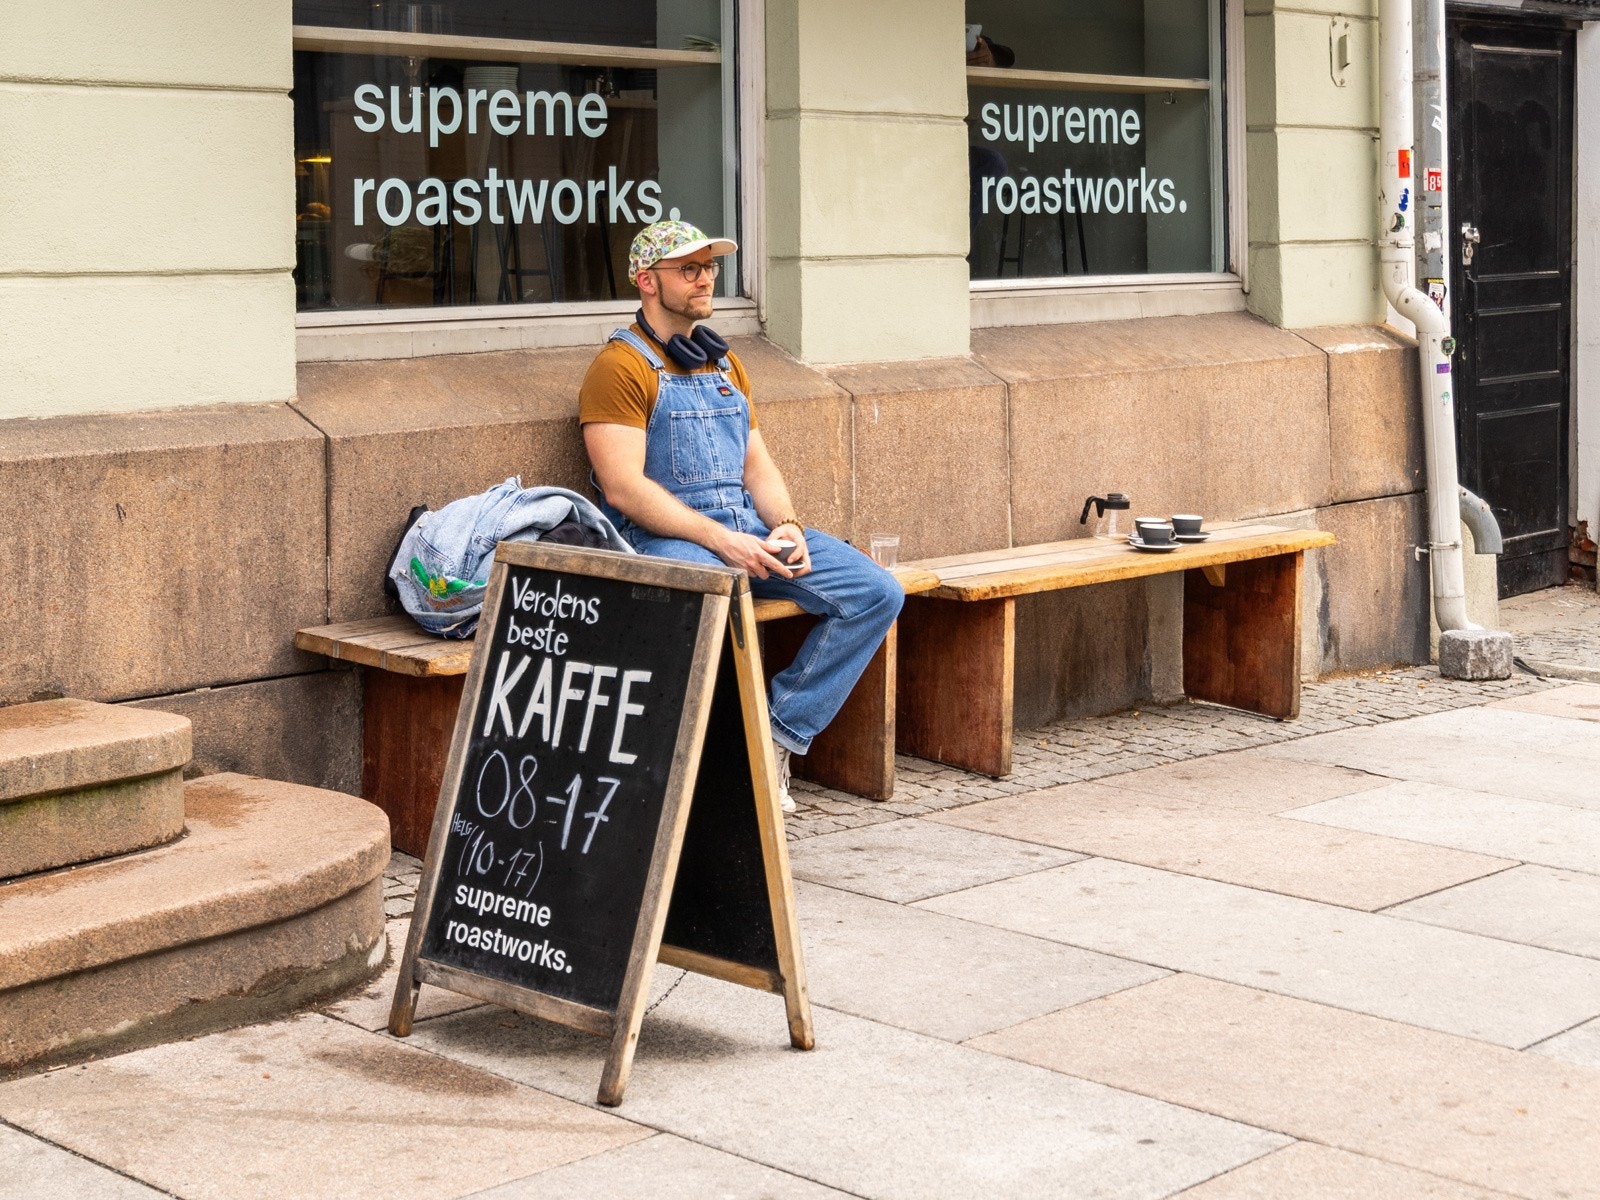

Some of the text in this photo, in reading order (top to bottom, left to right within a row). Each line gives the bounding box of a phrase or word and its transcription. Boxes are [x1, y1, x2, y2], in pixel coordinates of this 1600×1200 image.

[353, 84, 608, 148] supreme
[981, 102, 1141, 153] supreme
[353, 166, 682, 227] roastworks.
[981, 167, 1188, 215] roastworks.
[512, 576, 601, 625] Verdens
[506, 615, 569, 656] beste
[483, 650, 652, 765] KAFFE
[455, 884, 552, 927] supreme
[446, 919, 573, 974] roastworks.
